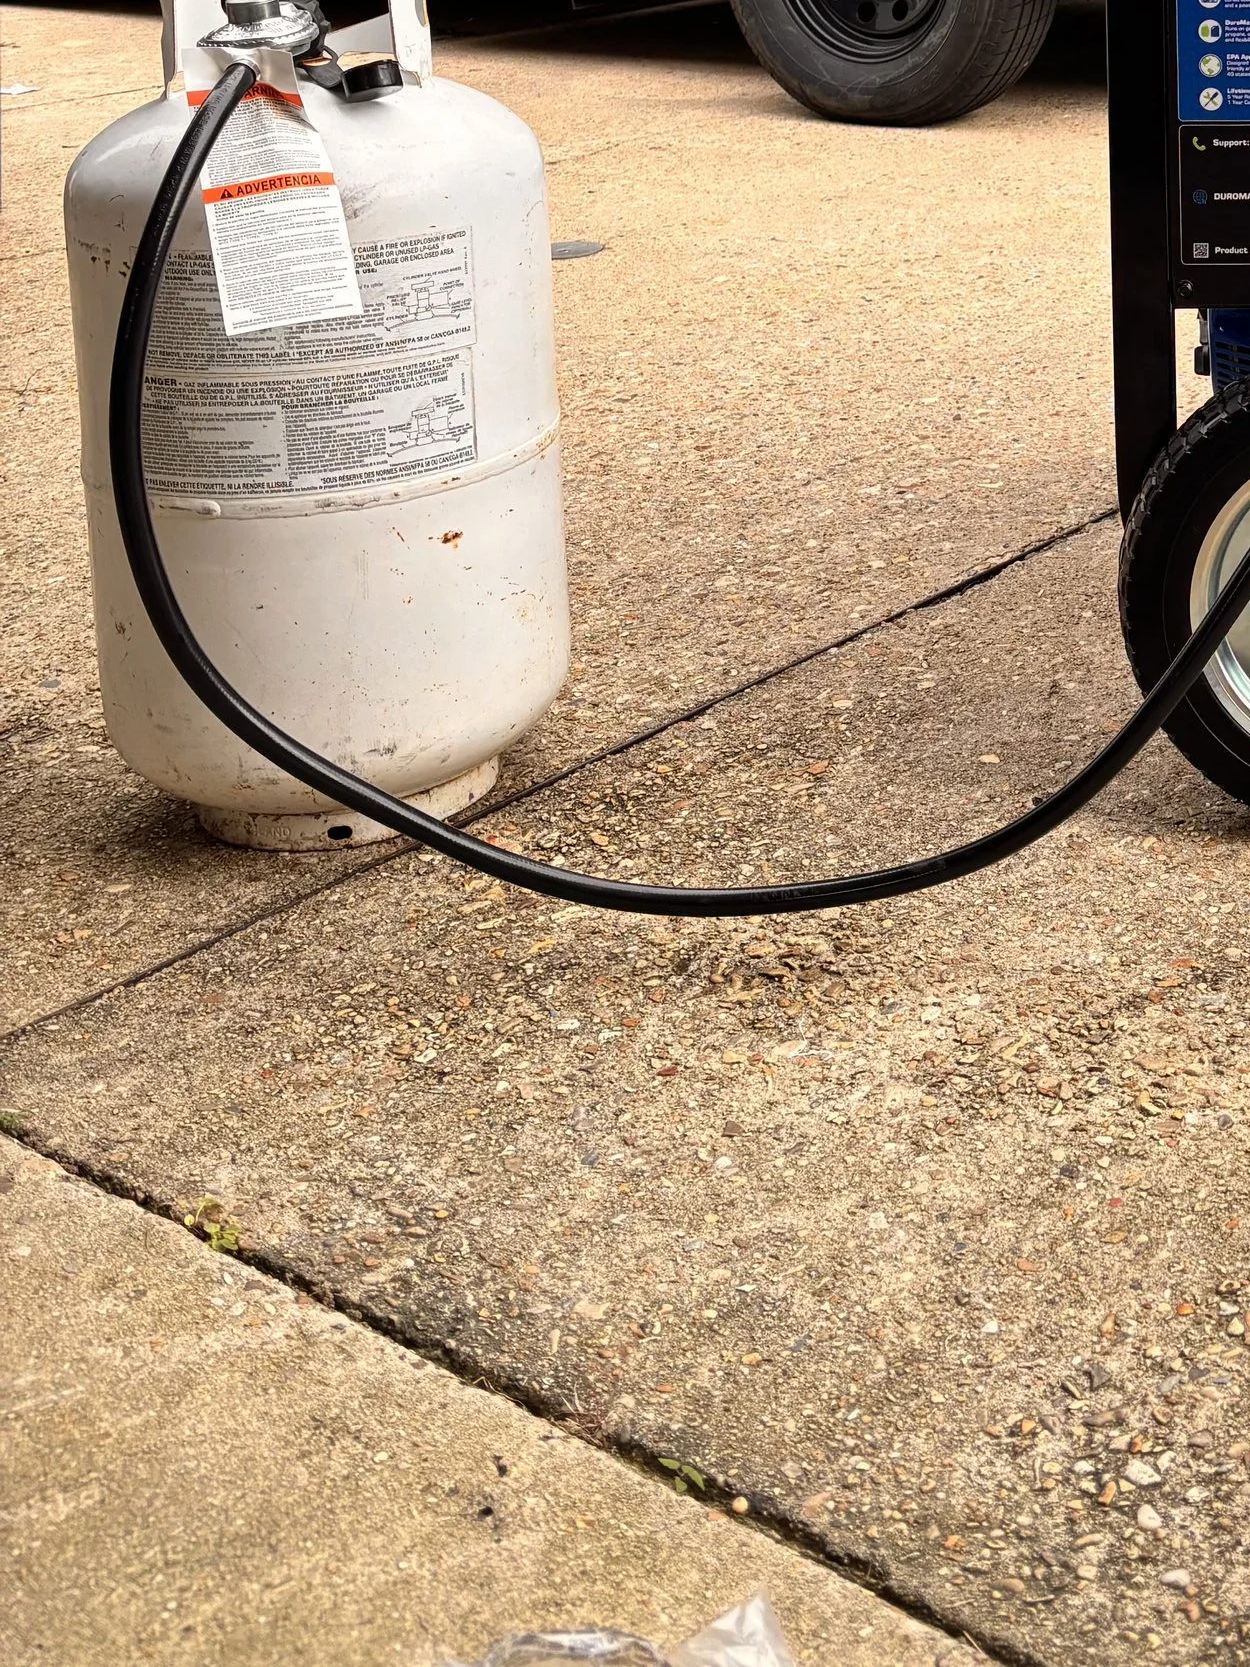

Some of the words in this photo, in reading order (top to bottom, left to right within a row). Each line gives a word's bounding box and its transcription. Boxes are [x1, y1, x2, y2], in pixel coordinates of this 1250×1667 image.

[1212, 138, 1250, 148] Support:
[236, 174, 321, 196] ADVERTENCIA
[358, 245, 378, 254] CAUSE
[385, 242, 399, 250] FIRE
[409, 236, 440, 247] EXPLOSION
[1214, 246, 1248, 254] Product
[354, 251, 385, 262] CYLINDER
[395, 248, 419, 256] UNUSED
[419, 243, 440, 253] LP-GAS
[355, 260, 372, 269] DING,
[373, 258, 399, 267] GARAGE
[400, 255, 409, 263] OR
[409, 251, 440, 261] ENCLOSED
[440, 247, 455, 256] AREA
[182, 351, 206, 359] DEFACE
[335, 343, 375, 354] AUTHORIZED
